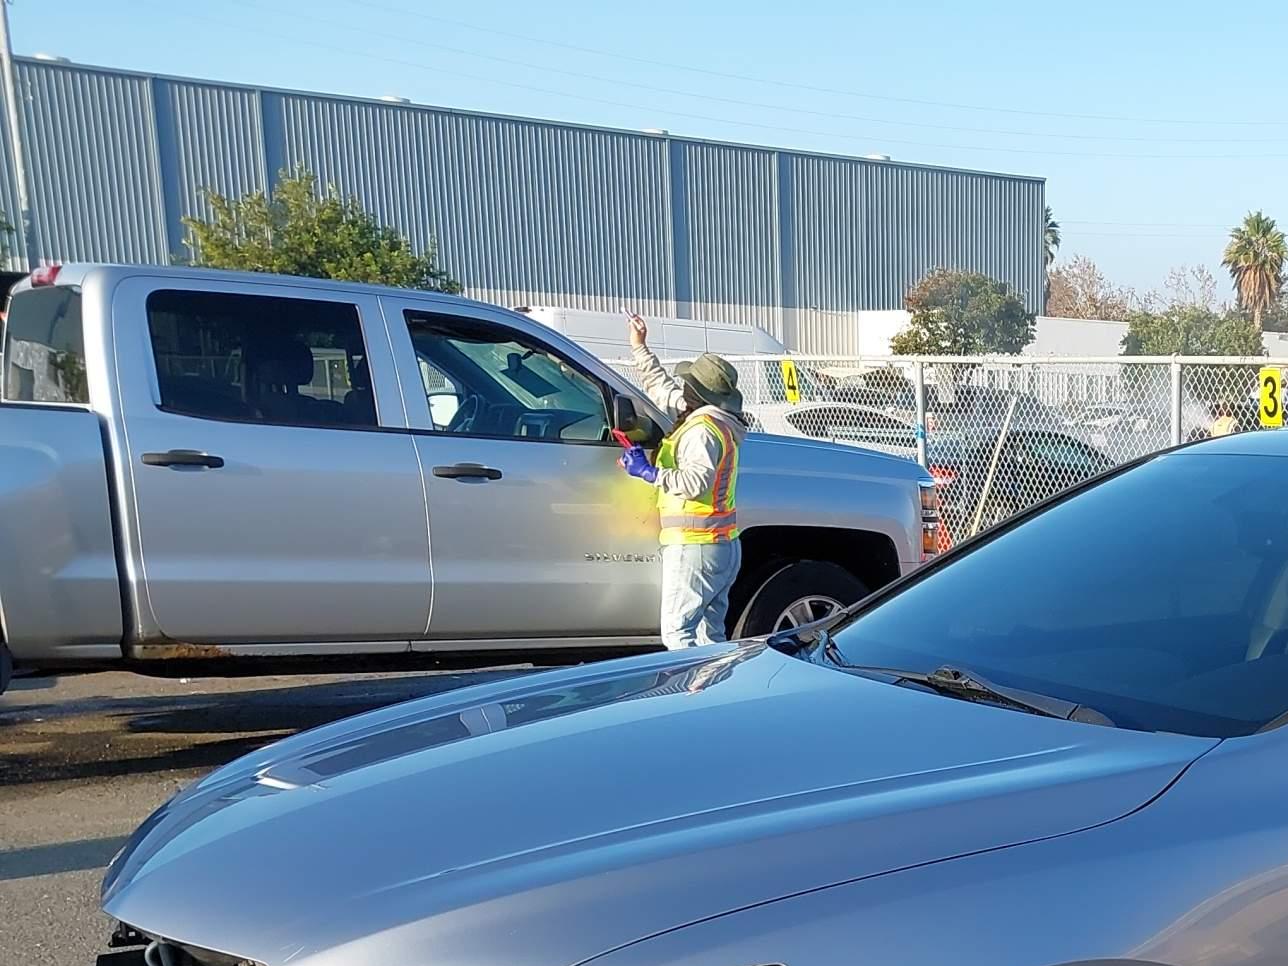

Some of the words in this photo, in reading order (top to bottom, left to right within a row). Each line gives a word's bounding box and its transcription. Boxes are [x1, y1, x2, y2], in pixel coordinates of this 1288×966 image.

[787, 367, 797, 395] 4
[1263, 376, 1279, 418] 3
[583, 552, 662, 562] SILVERA
